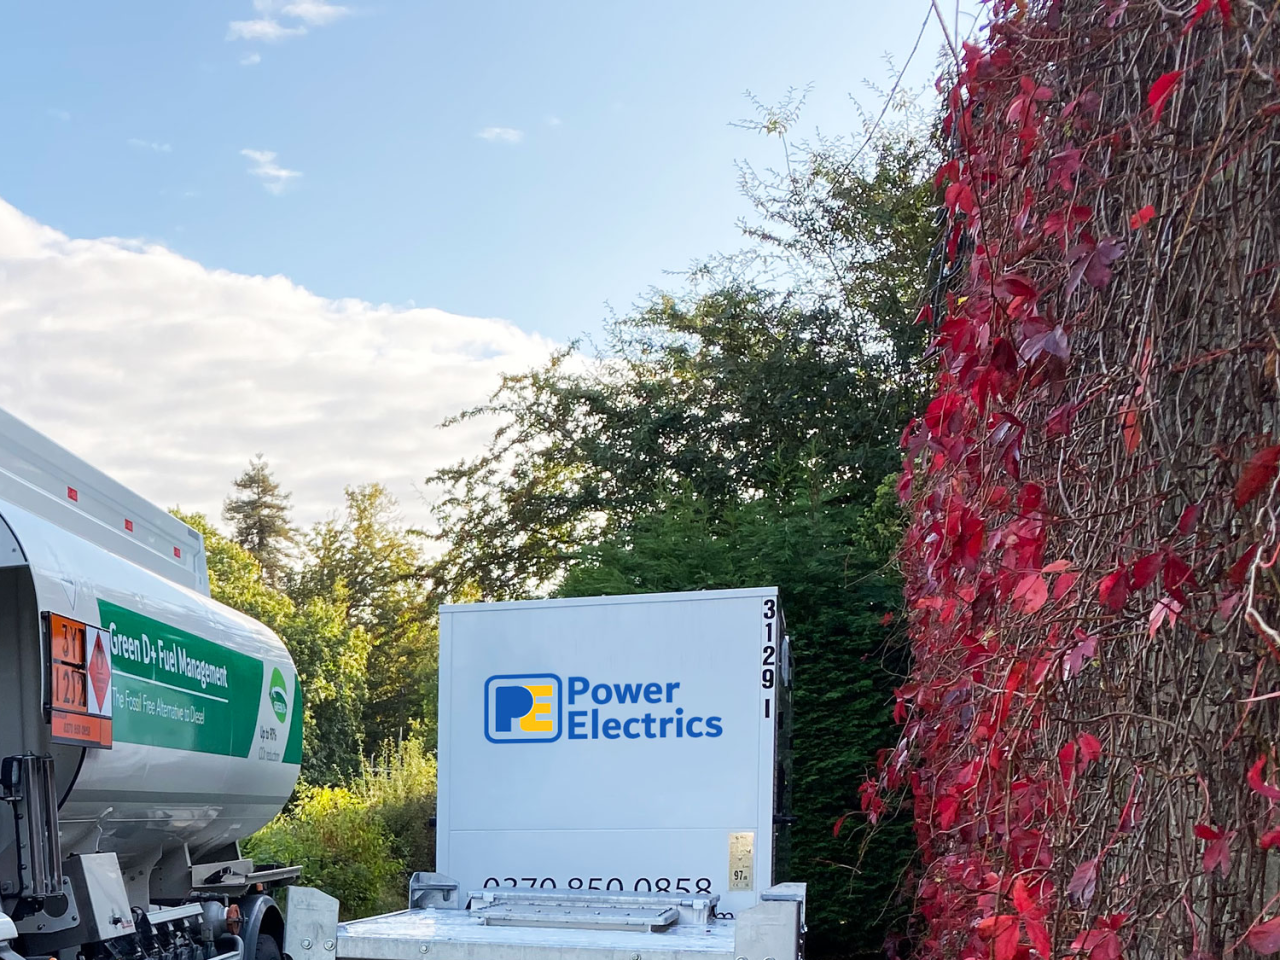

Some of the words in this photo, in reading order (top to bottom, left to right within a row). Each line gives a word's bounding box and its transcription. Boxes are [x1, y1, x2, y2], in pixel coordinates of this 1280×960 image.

[109, 622, 141, 662] Green
[142, 634, 156, 664] D+
[157, 639, 177, 673] Fuel
[178, 647, 228, 689] Management
[112, 686, 124, 708] The
[126, 690, 141, 711] Fossil
[143, 694, 155, 715] Free
[156, 698, 183, 720] Alternative
[185, 706, 189, 721] to
[191, 706, 205, 724] Diesel
[567, 676, 680, 705] Power
[567, 707, 724, 740] Electrics
[734, 870, 743, 880] 97
